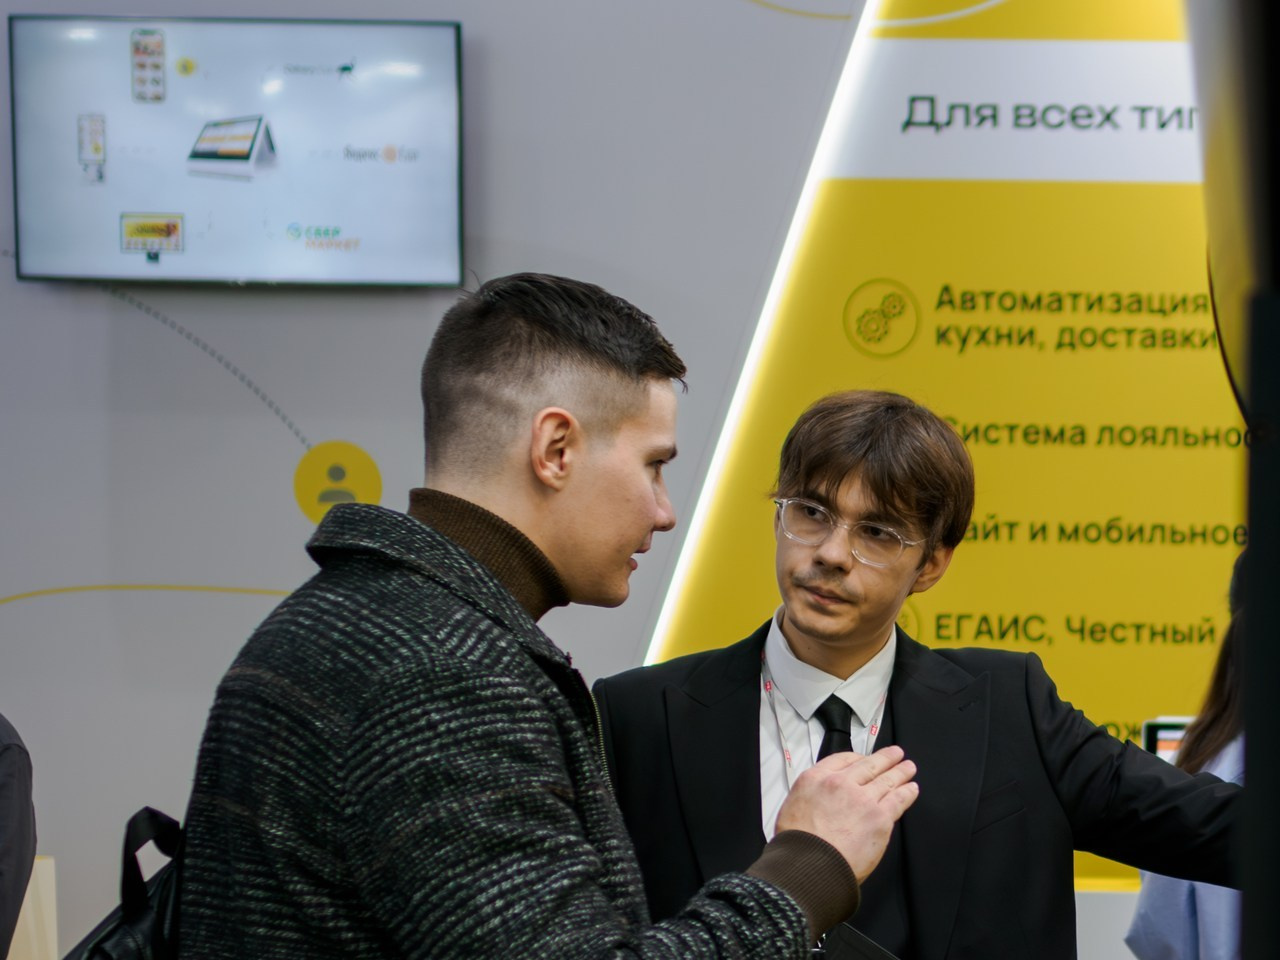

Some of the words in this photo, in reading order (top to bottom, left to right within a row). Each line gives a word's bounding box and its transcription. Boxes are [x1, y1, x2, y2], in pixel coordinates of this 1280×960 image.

[901, 95, 998, 134] Для
[1013, 103, 1120, 129] всех
[936, 284, 1209, 316] Автоматизация
[936, 326, 1046, 354] кухни,
[1056, 327, 1218, 350] доставки
[963, 513, 1020, 541] айт
[1030, 522, 1048, 541] и
[1058, 516, 1249, 546] мобильное
[935, 613, 1053, 645] ЕГАИС,
[1067, 615, 1216, 644] Честный
